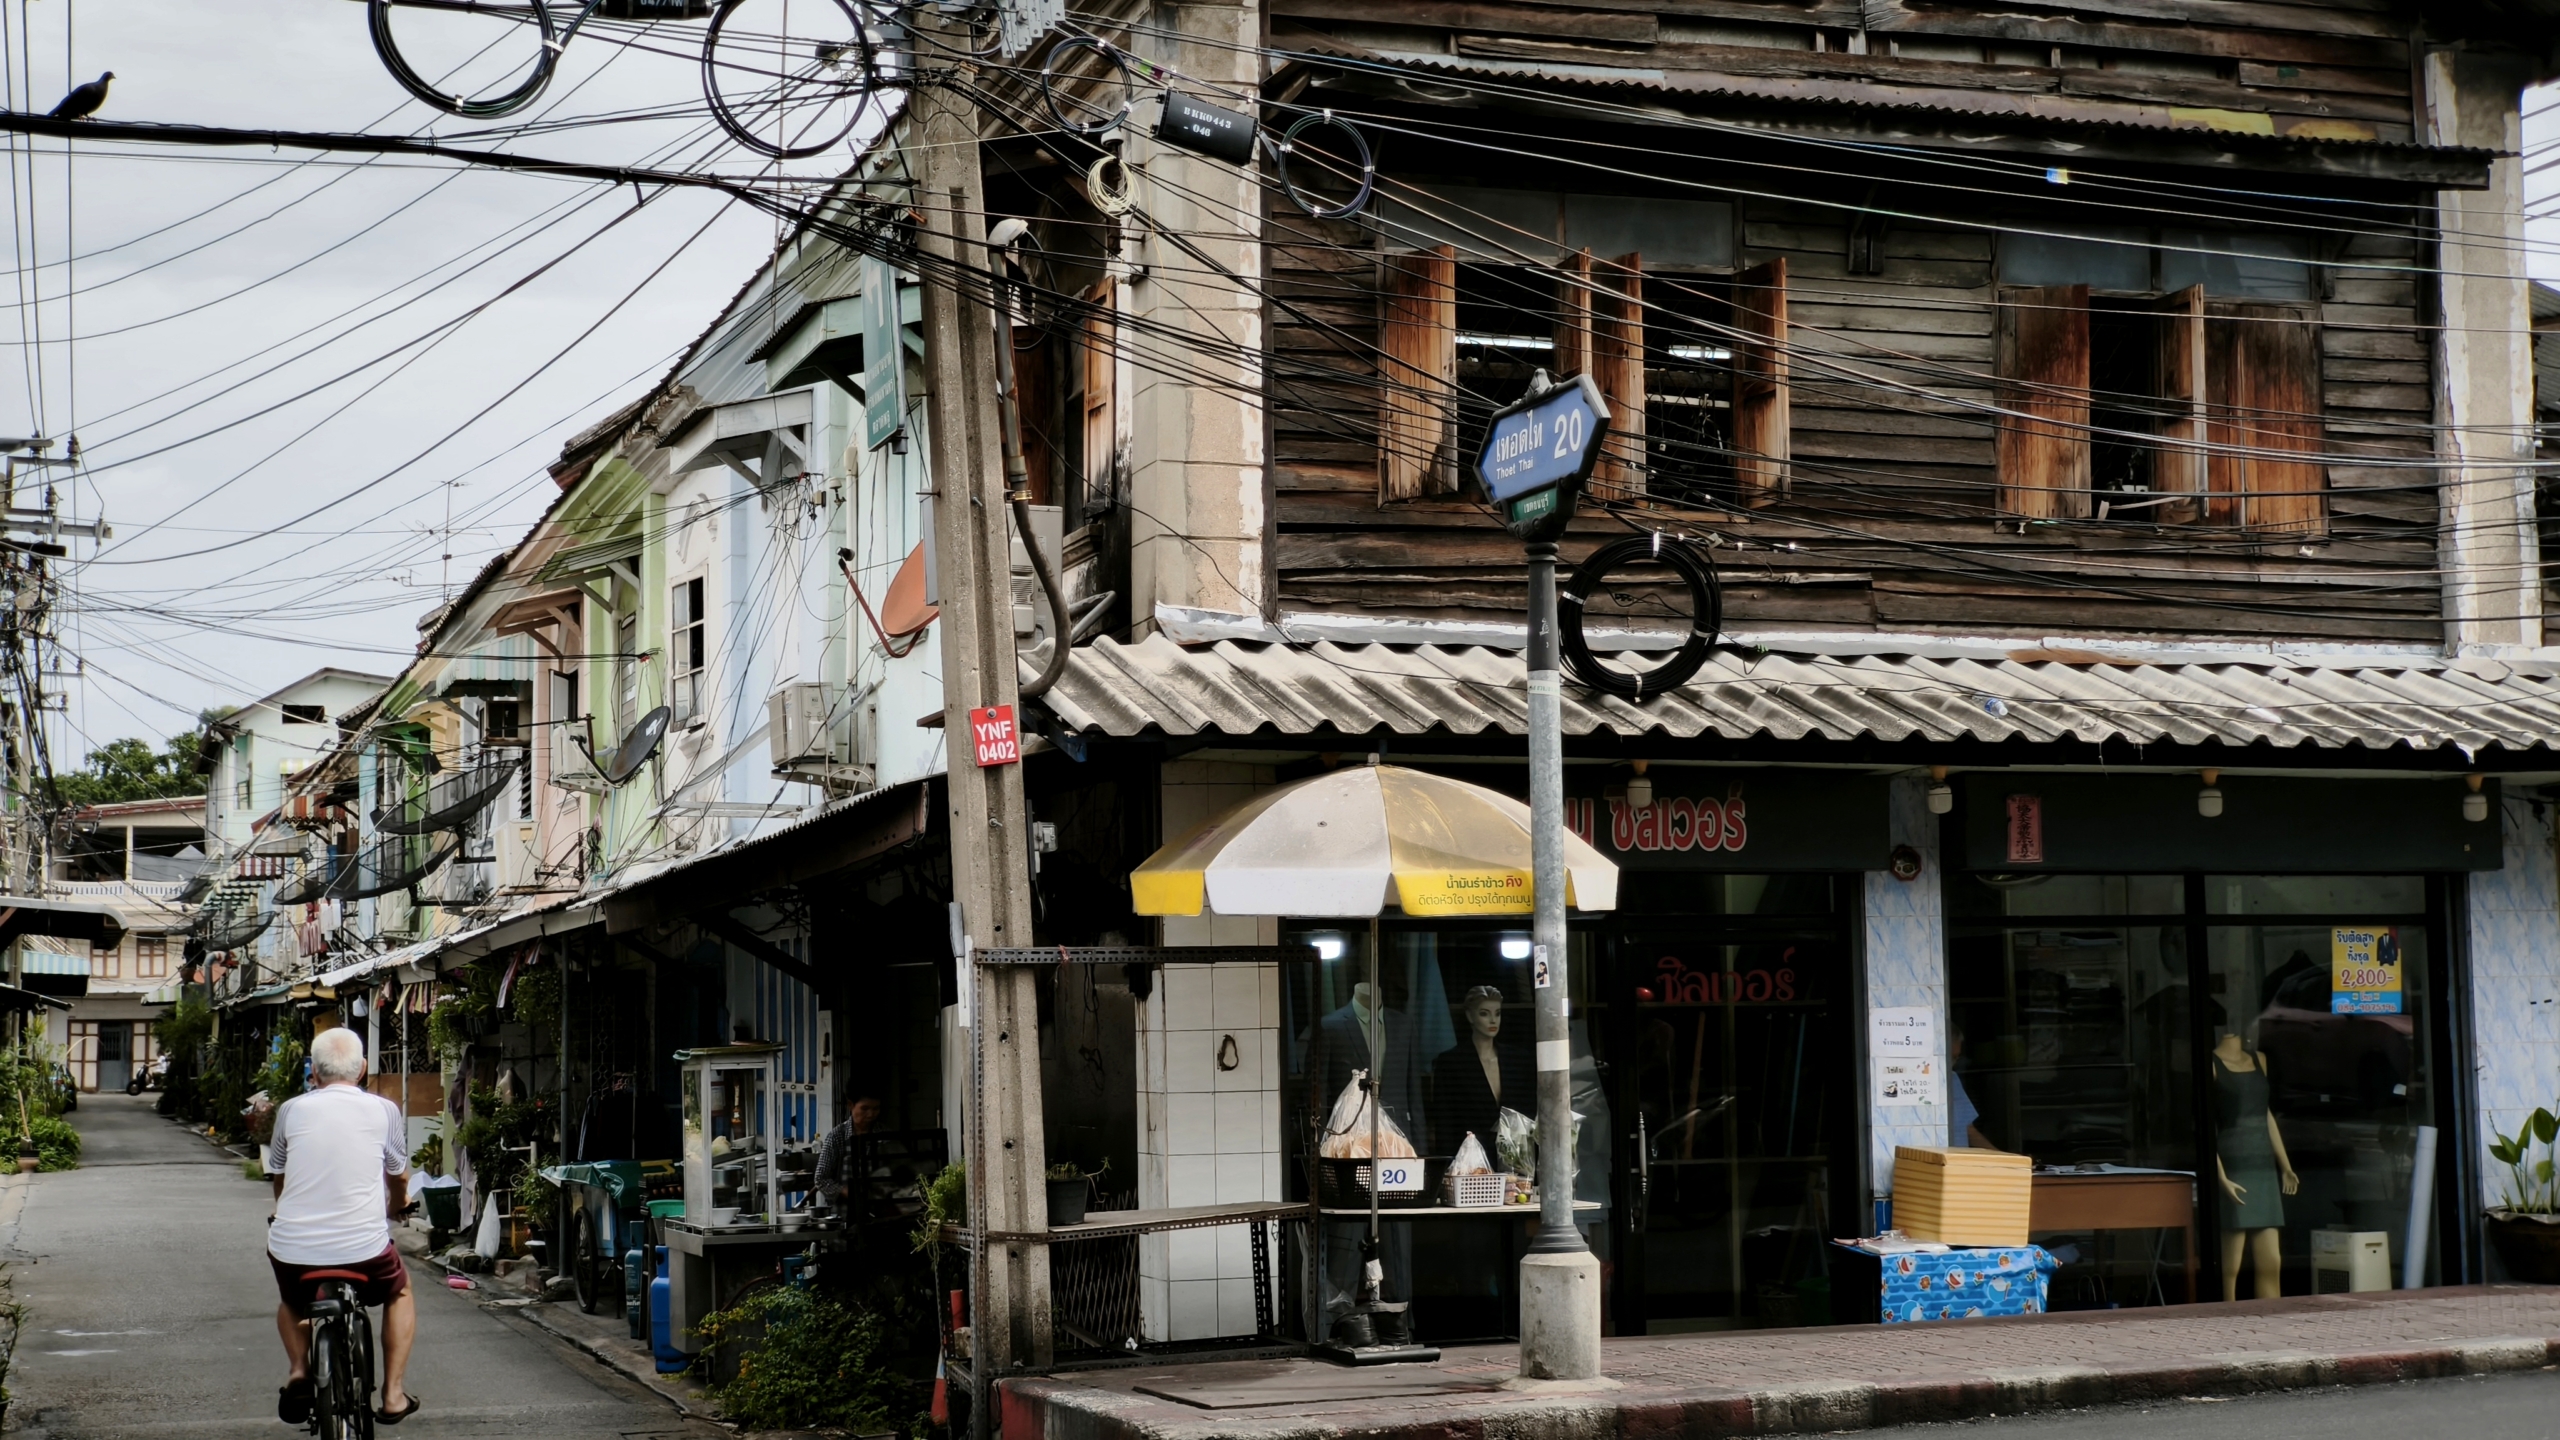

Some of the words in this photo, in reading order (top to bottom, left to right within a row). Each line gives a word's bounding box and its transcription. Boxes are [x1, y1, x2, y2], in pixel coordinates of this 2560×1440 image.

[1496, 409, 1543, 463] เทอดไท
[1553, 408, 1582, 459] 20
[1496, 464, 1516, 480] Thoet
[1518, 456, 1534, 472] Thai
[975, 720, 1012, 742] YNF
[979, 740, 1016, 763] 0402
[2336, 930, 2375, 947] รับตัดสูท
[1909, 1016, 1914, 1026] 3
[1905, 1036, 1911, 1045] 5
[1382, 1169, 1407, 1185] 20
